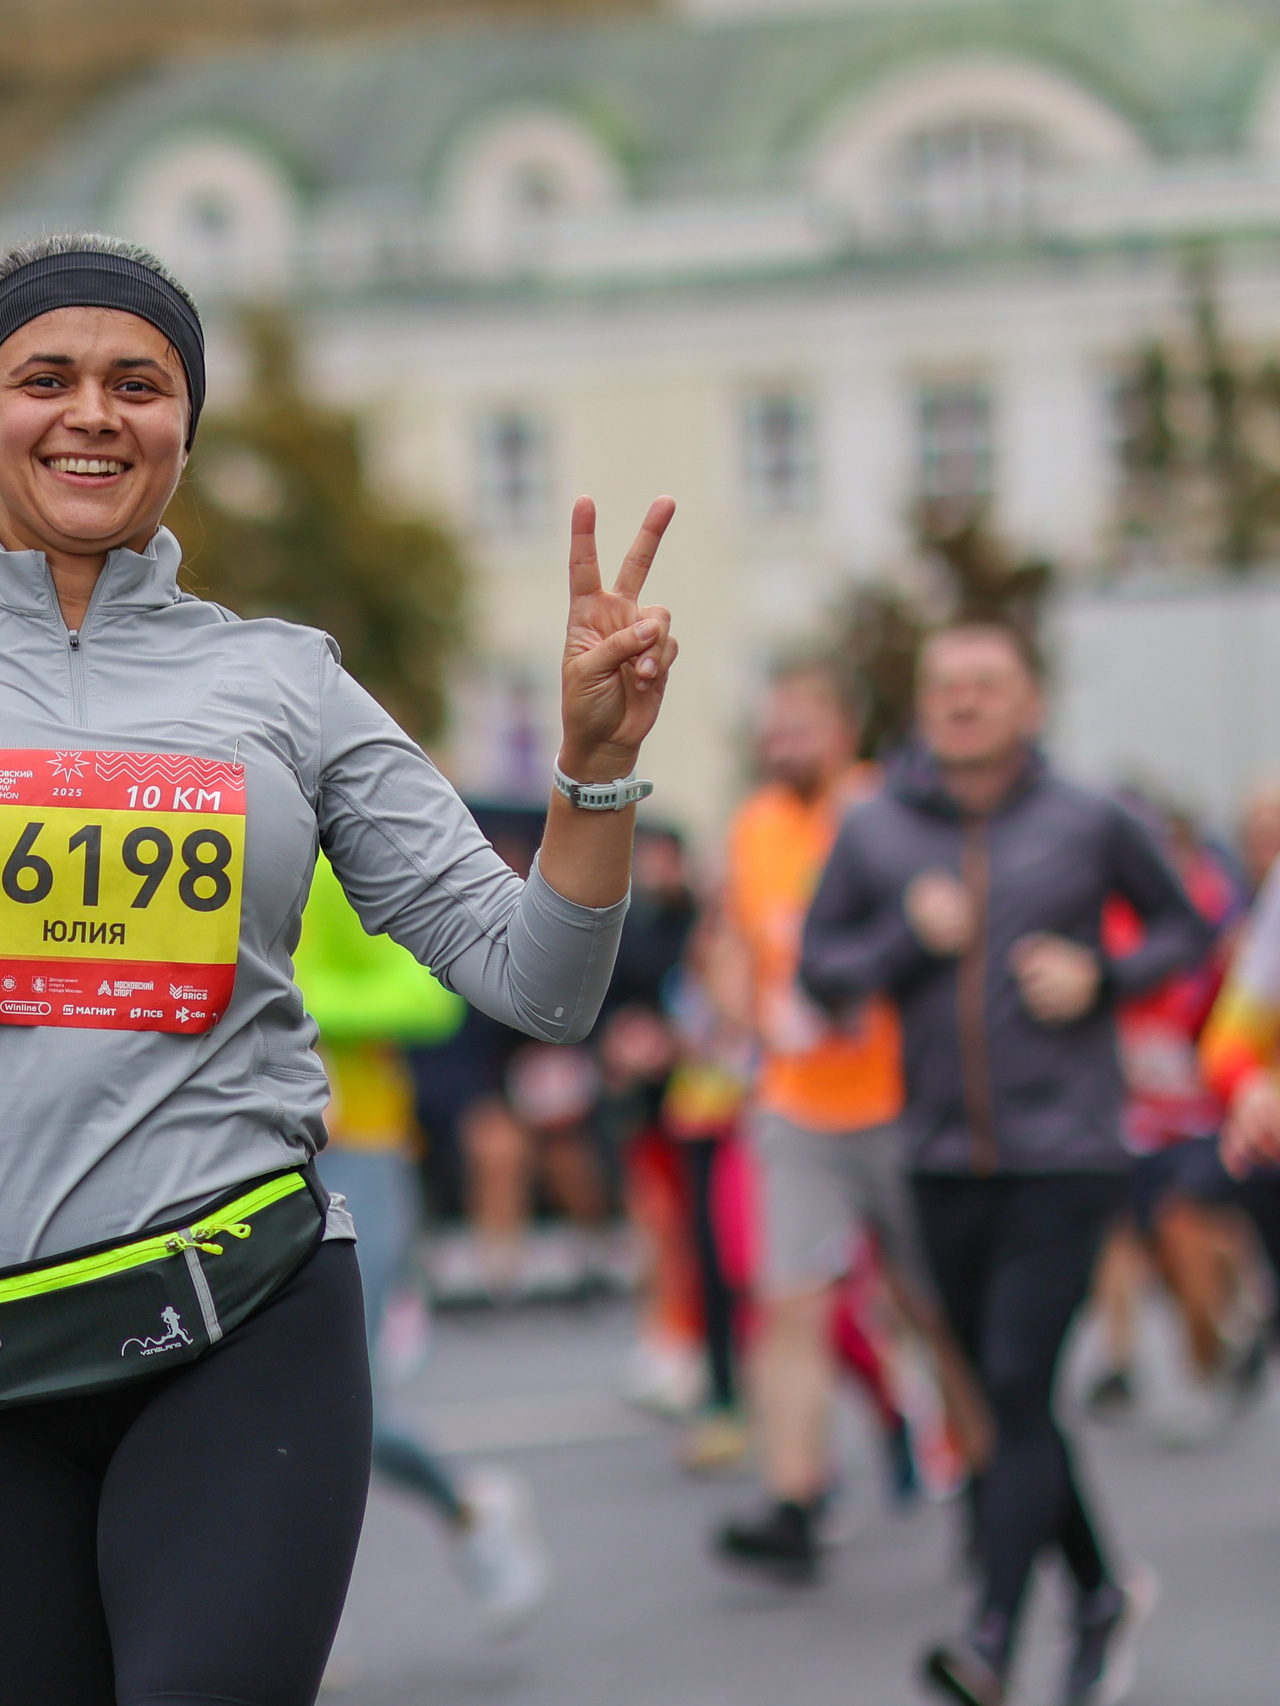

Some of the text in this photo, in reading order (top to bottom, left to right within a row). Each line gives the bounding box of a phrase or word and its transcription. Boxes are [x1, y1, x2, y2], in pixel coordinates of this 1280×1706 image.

[52, 787, 82, 797] 2025
[126, 785, 161, 809] 10
[42, 920, 126, 945] ЮЛИЯ
[114, 980, 154, 990] МОСКОВСКИЙ
[113, 989, 133, 997] СПОРТ
[182, 992, 208, 1000] BRICS
[4, 1003, 37, 1012] Winline
[76, 1006, 117, 1016] МАГНИТ
[143, 1009, 163, 1018] ПСБ
